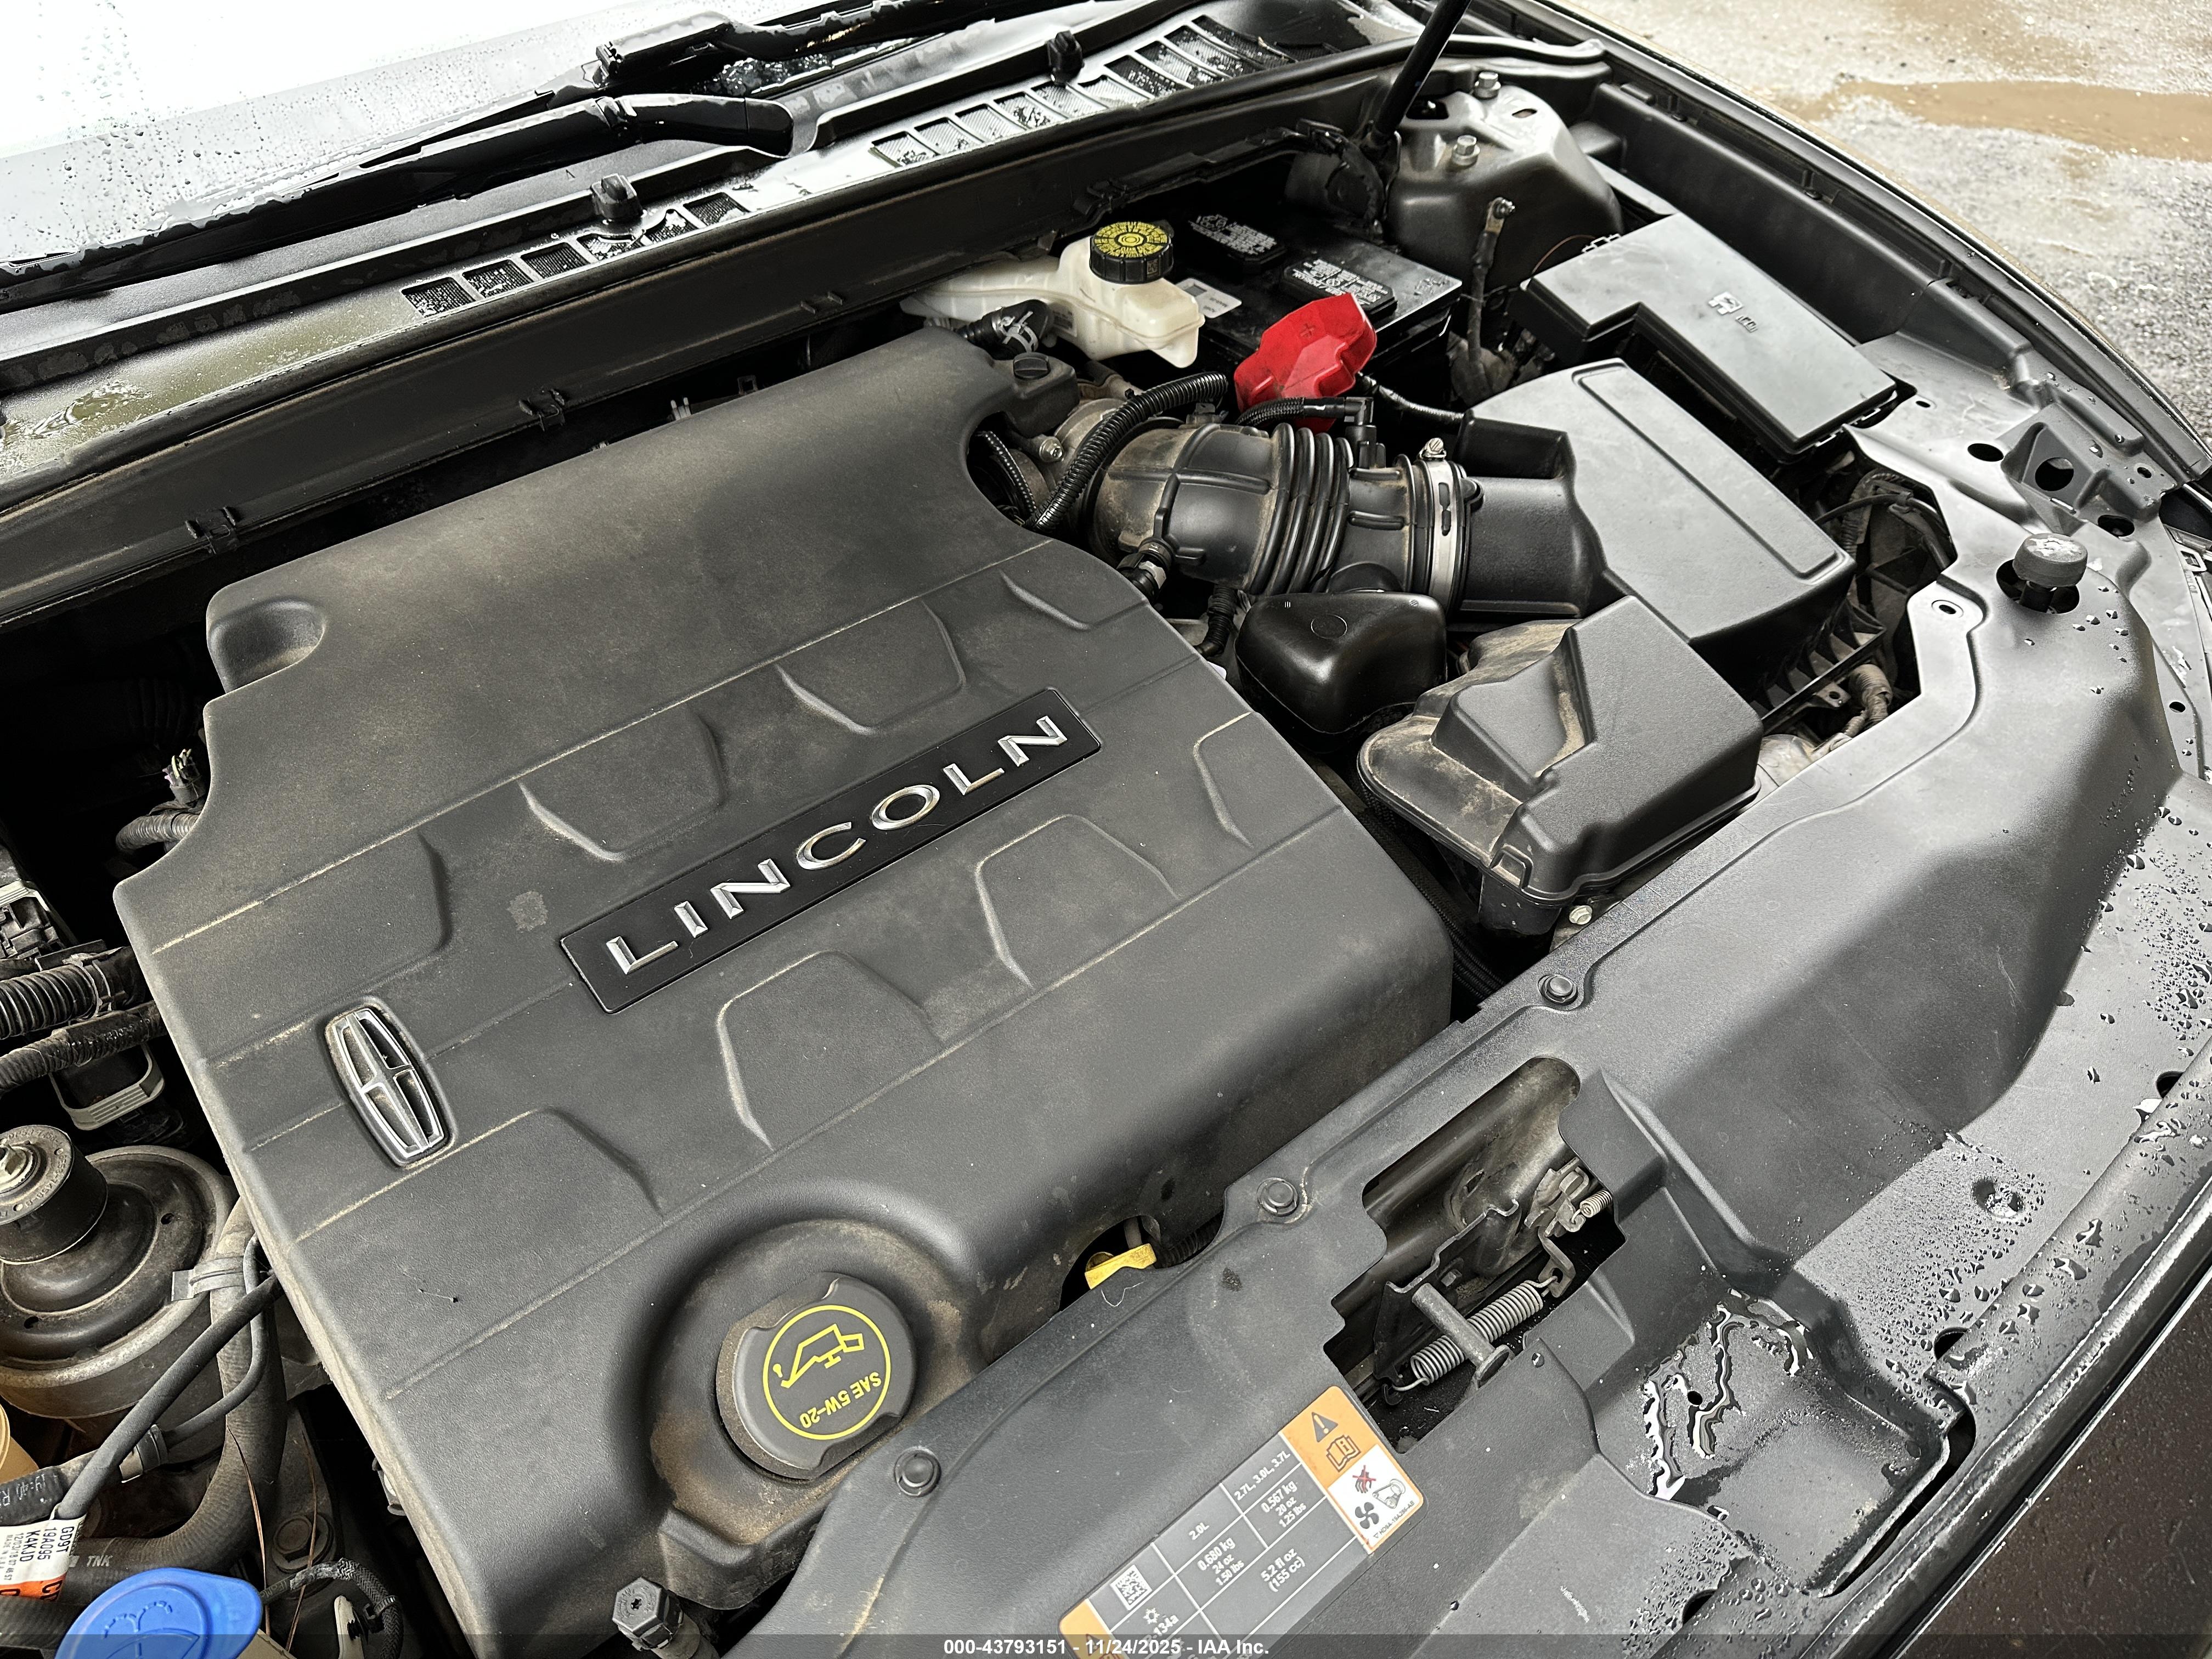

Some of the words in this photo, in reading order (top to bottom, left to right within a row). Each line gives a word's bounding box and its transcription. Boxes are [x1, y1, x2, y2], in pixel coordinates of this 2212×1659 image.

[606, 715, 1068, 975] LINCOLN
[851, 1372, 881, 1399] SAE
[800, 1391, 851, 1429] 5W-20
[1234, 1483, 1256, 1500] 2.7L,
[1252, 1467, 1274, 1483] 3.0L,
[1271, 1451, 1290, 1467] 3.7L
[1261, 1489, 1284, 1513] 0.567
[1282, 1481, 1297, 1494] kg
[1276, 1504, 1286, 1516] 20
[1286, 1497, 1296, 1508] oz
[1279, 1511, 1295, 1527] 1.25
[1293, 1503, 1306, 1515] lbs
[20, 1530, 41, 1562] K4KJD
[37, 1527, 57, 1560] 19A095
[57, 1526, 74, 1553] GD9T
[1189, 1522, 1210, 1541] 2.0L
[86, 1555, 114, 1567] TNK
[1197, 1547, 1222, 1571] 0.680
[1219, 1538, 1235, 1551] kg
[1212, 1561, 1224, 1575] 24
[1223, 1554, 1234, 1565] oz
[1261, 1564, 1278, 1582] 5.2
[1274, 1557, 1285, 1569] fl
[1284, 1548, 1297, 1561] oz
[1215, 1569, 1233, 1586] 1.50
[1229, 1560, 1244, 1573] lbs
[1268, 1568, 1290, 1592] (155
[1289, 1556, 1305, 1573] cc)
